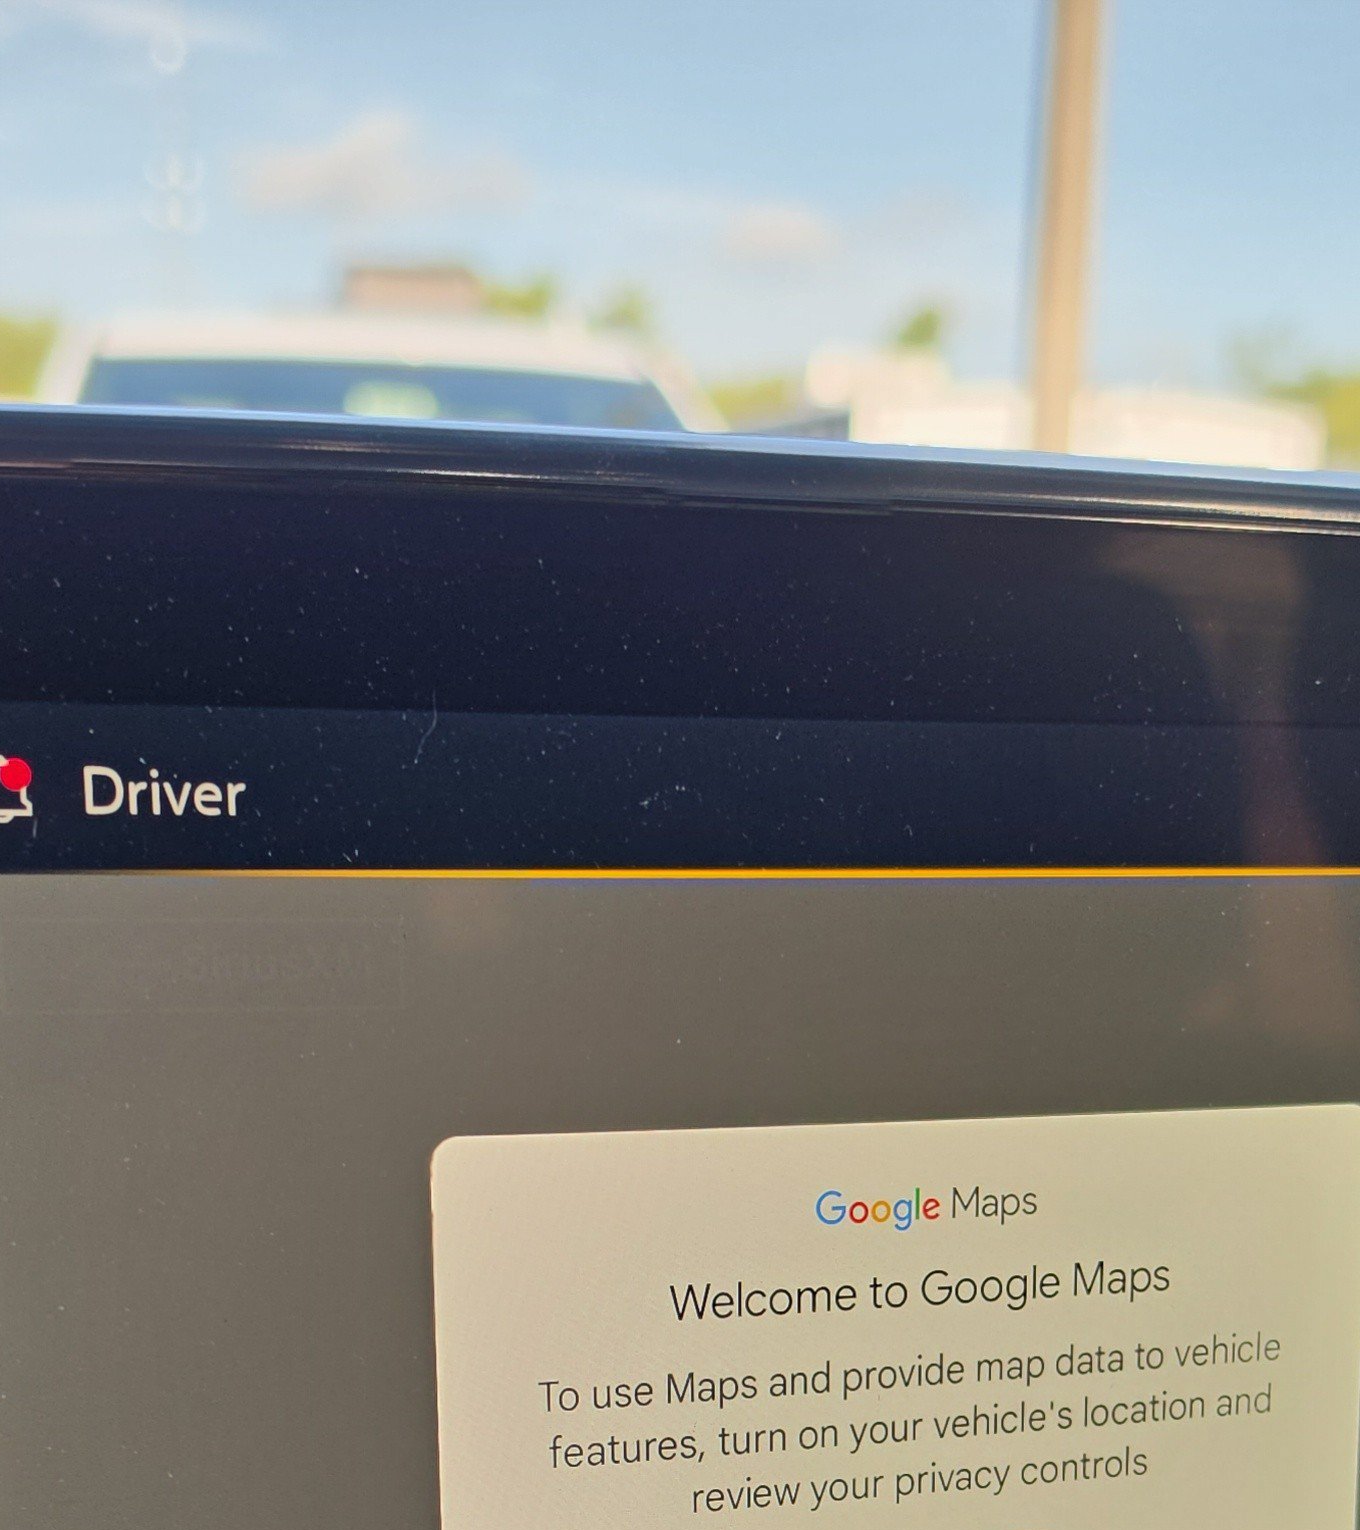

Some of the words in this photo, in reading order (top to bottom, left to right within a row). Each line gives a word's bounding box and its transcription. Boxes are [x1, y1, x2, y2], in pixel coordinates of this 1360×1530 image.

[83, 765, 247, 817] Driver
[813, 1186, 941, 1233] Google
[951, 1185, 1038, 1226] Maps
[668, 1280, 858, 1322] Welcome
[868, 1276, 908, 1309] to
[920, 1264, 1061, 1311] Google
[1073, 1260, 1170, 1303] Maps
[537, 1380, 581, 1413] To
[593, 1382, 654, 1411] use
[665, 1371, 758, 1410] Maps
[769, 1359, 831, 1398] and
[843, 1352, 965, 1401] provide
[976, 1355, 1045, 1387] map
[1055, 1343, 1124, 1377] data
[1134, 1342, 1165, 1371] to
[1174, 1330, 1281, 1367] vehicle
[548, 1434, 705, 1469] features,
[717, 1427, 787, 1456] turn
[798, 1424, 839, 1451] on
[849, 1418, 924, 1455] your
[933, 1400, 1073, 1439] vehicle's
[1083, 1390, 1205, 1428] location
[1216, 1382, 1272, 1417] and
[692, 1476, 801, 1514] review
[810, 1475, 885, 1512] your
[895, 1461, 1011, 1505] privacy
[1020, 1445, 1148, 1486] controls
